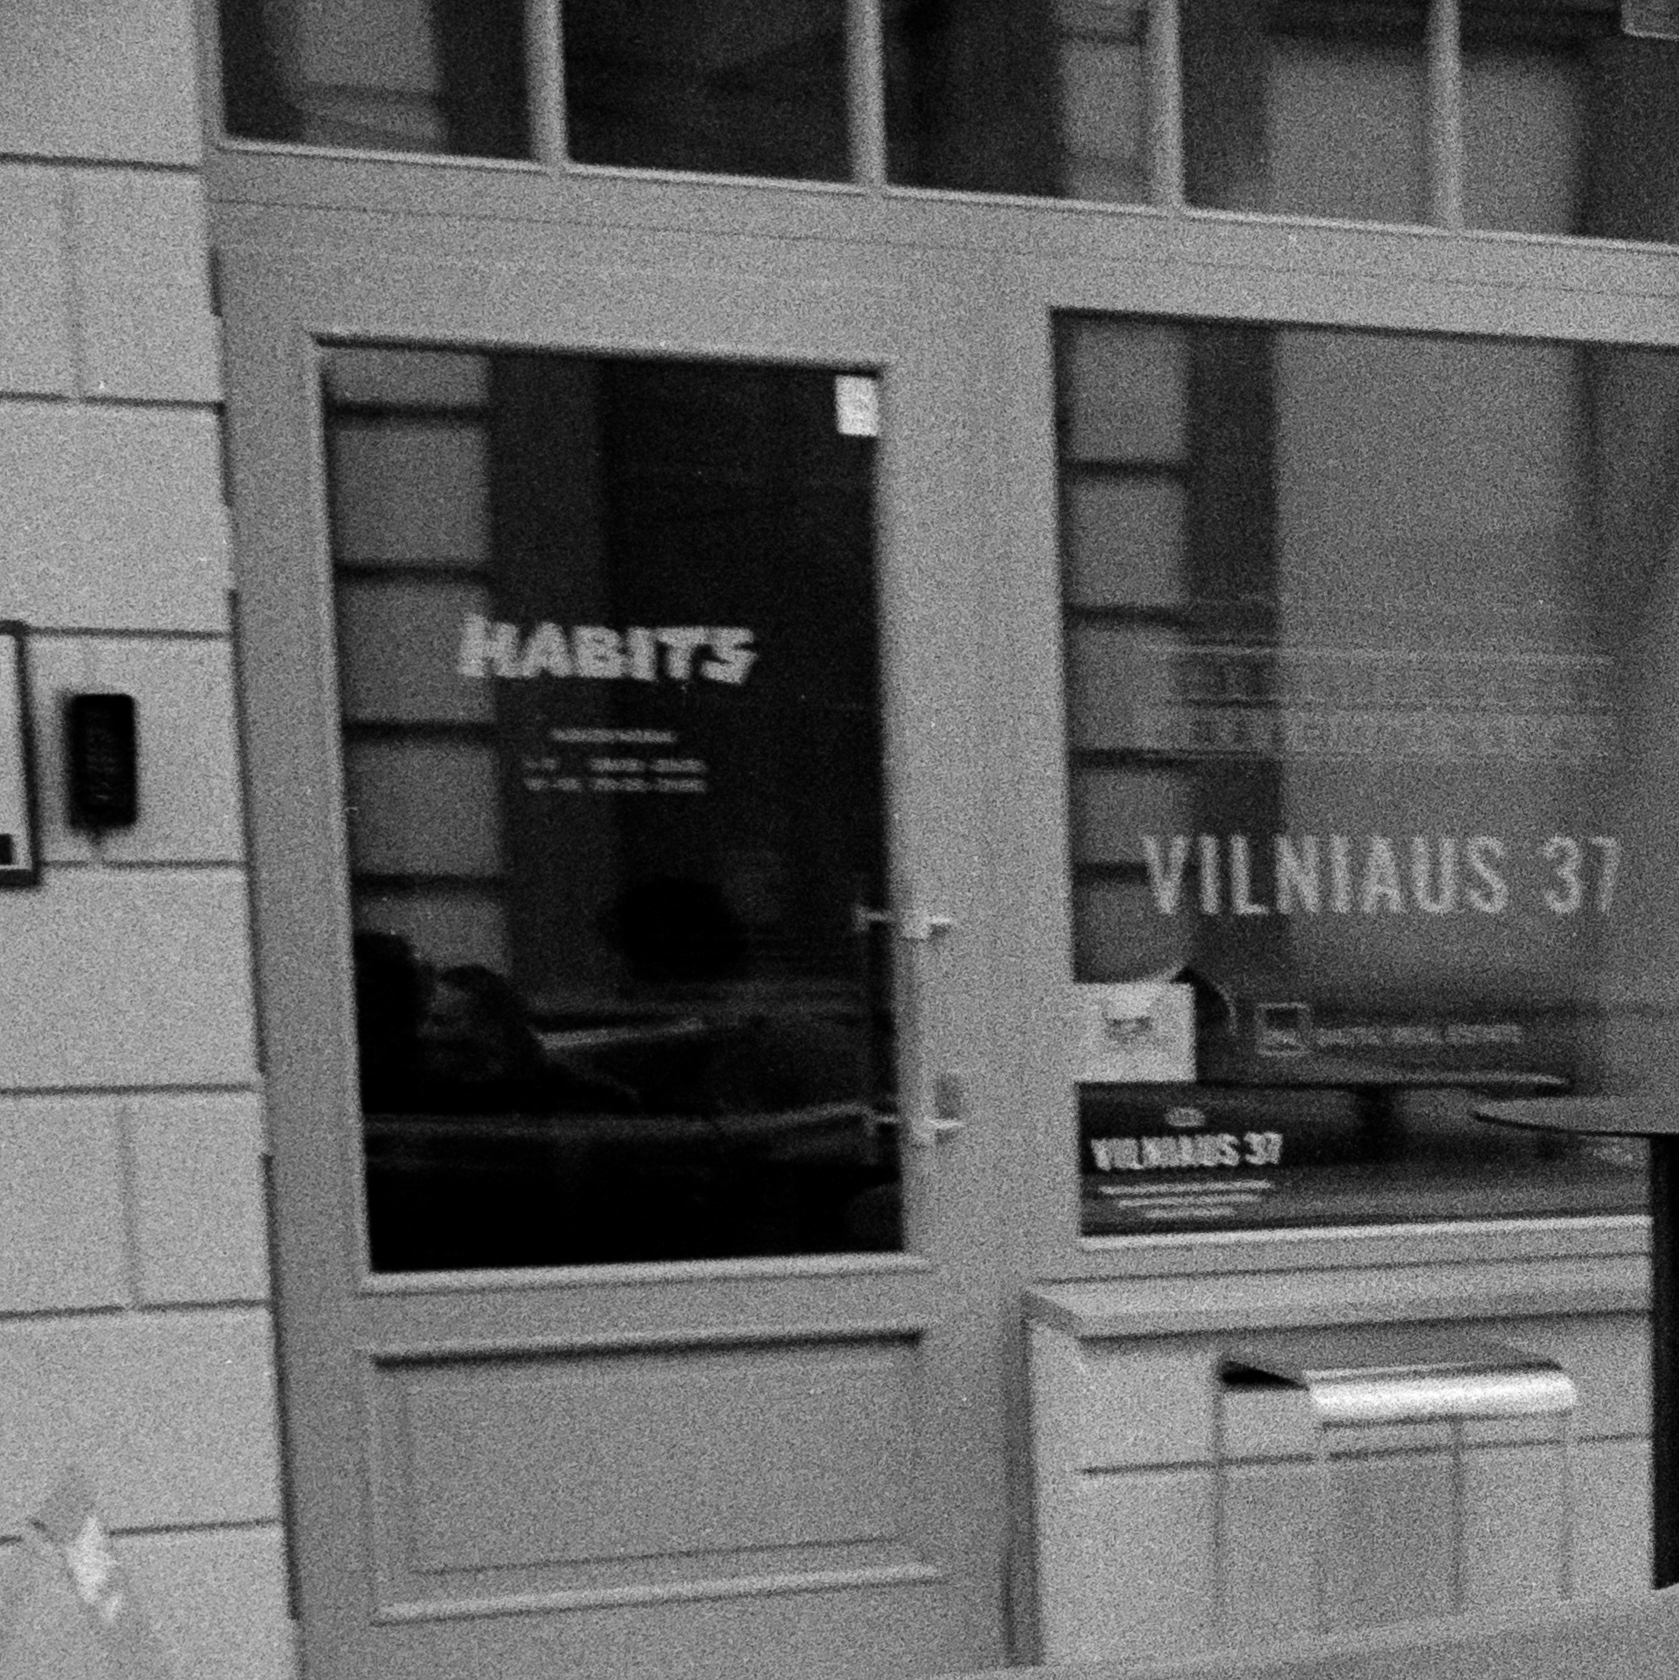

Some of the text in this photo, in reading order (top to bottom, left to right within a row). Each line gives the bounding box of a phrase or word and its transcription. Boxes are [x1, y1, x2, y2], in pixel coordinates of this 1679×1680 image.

[458, 611, 759, 686] HABITS
[1141, 833, 1622, 916] VILNIAUS 37
[1242, 1130, 1284, 1166] 37
